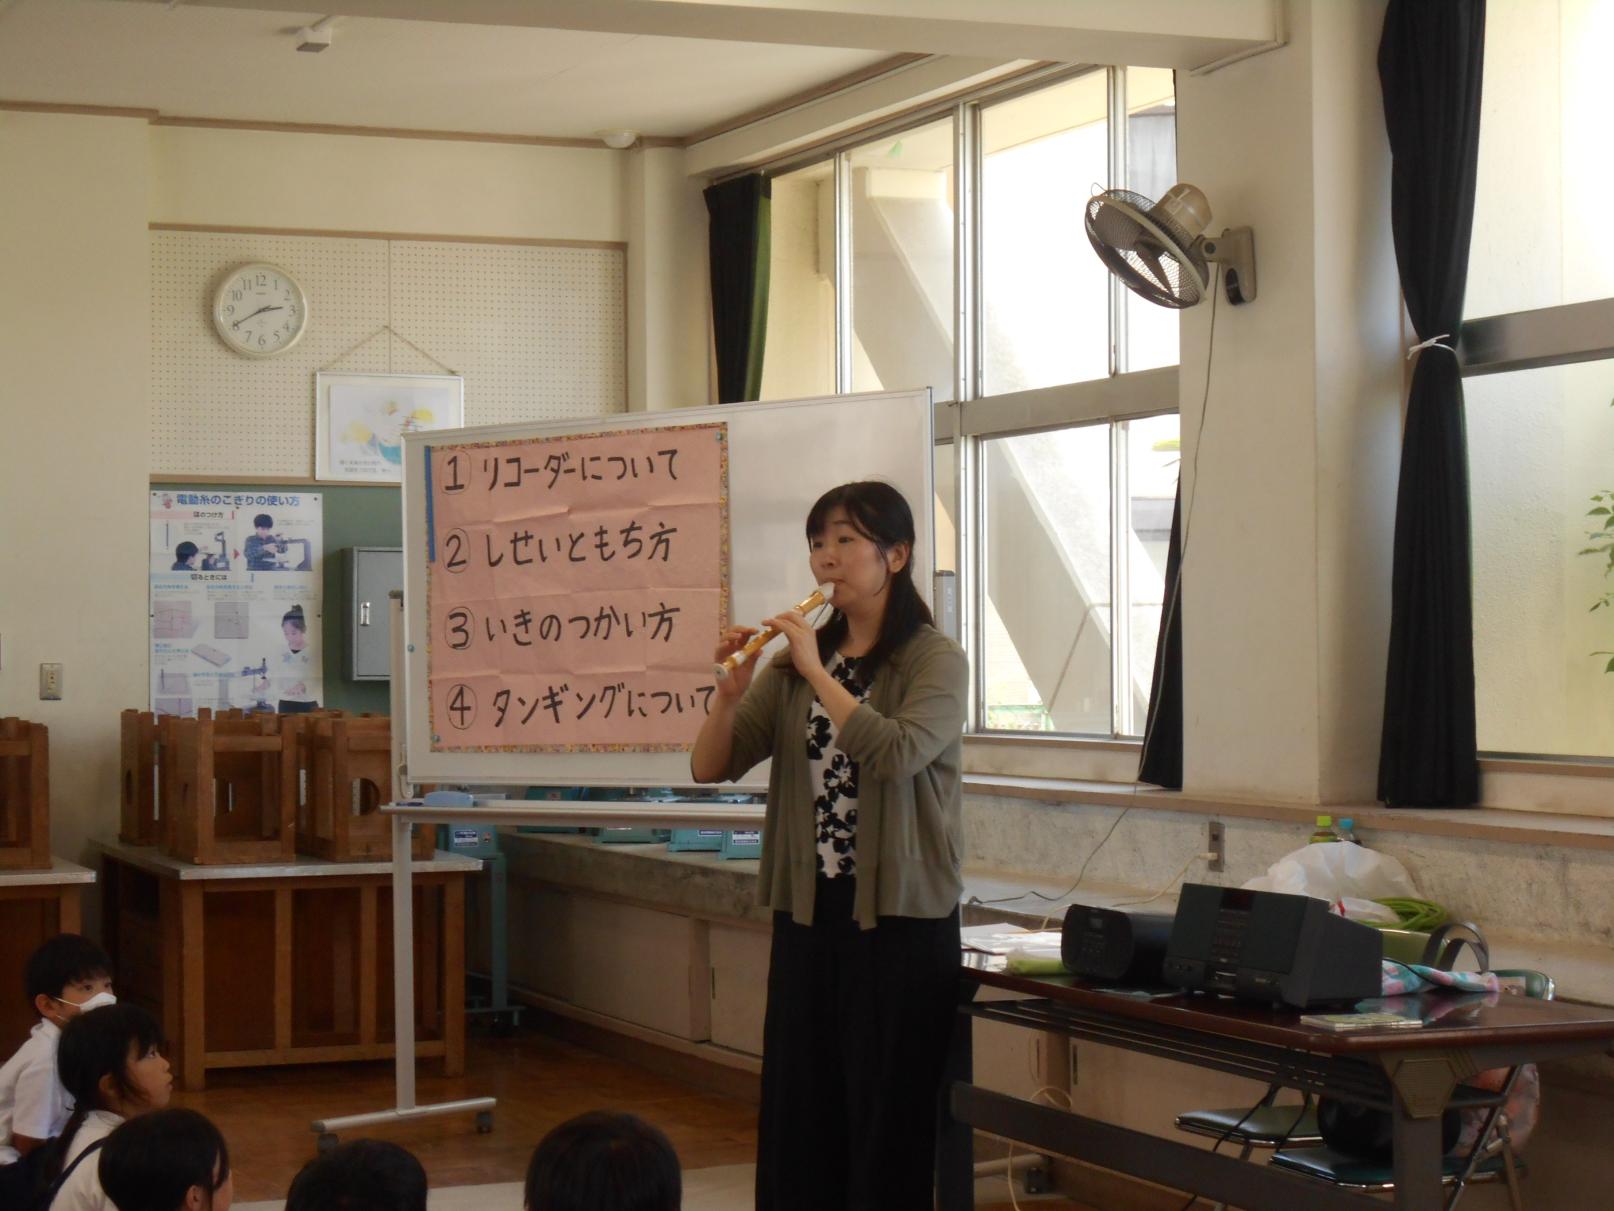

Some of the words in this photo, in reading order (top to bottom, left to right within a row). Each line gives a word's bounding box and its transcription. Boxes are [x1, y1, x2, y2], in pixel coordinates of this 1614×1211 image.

[241, 279, 252, 291] 11
[255, 274, 267, 287] 12
[231, 289, 243, 302] 10
[284, 289, 291, 301] 2
[226, 304, 235, 316] 9
[289, 304, 296, 317] 3
[282, 322, 290, 333] 4
[244, 330, 252, 343] 7
[257, 335, 266, 346] 6
[273, 330, 281, 342] 5
[176, 493, 301, 507] 電動糸のこぎりの使い方
